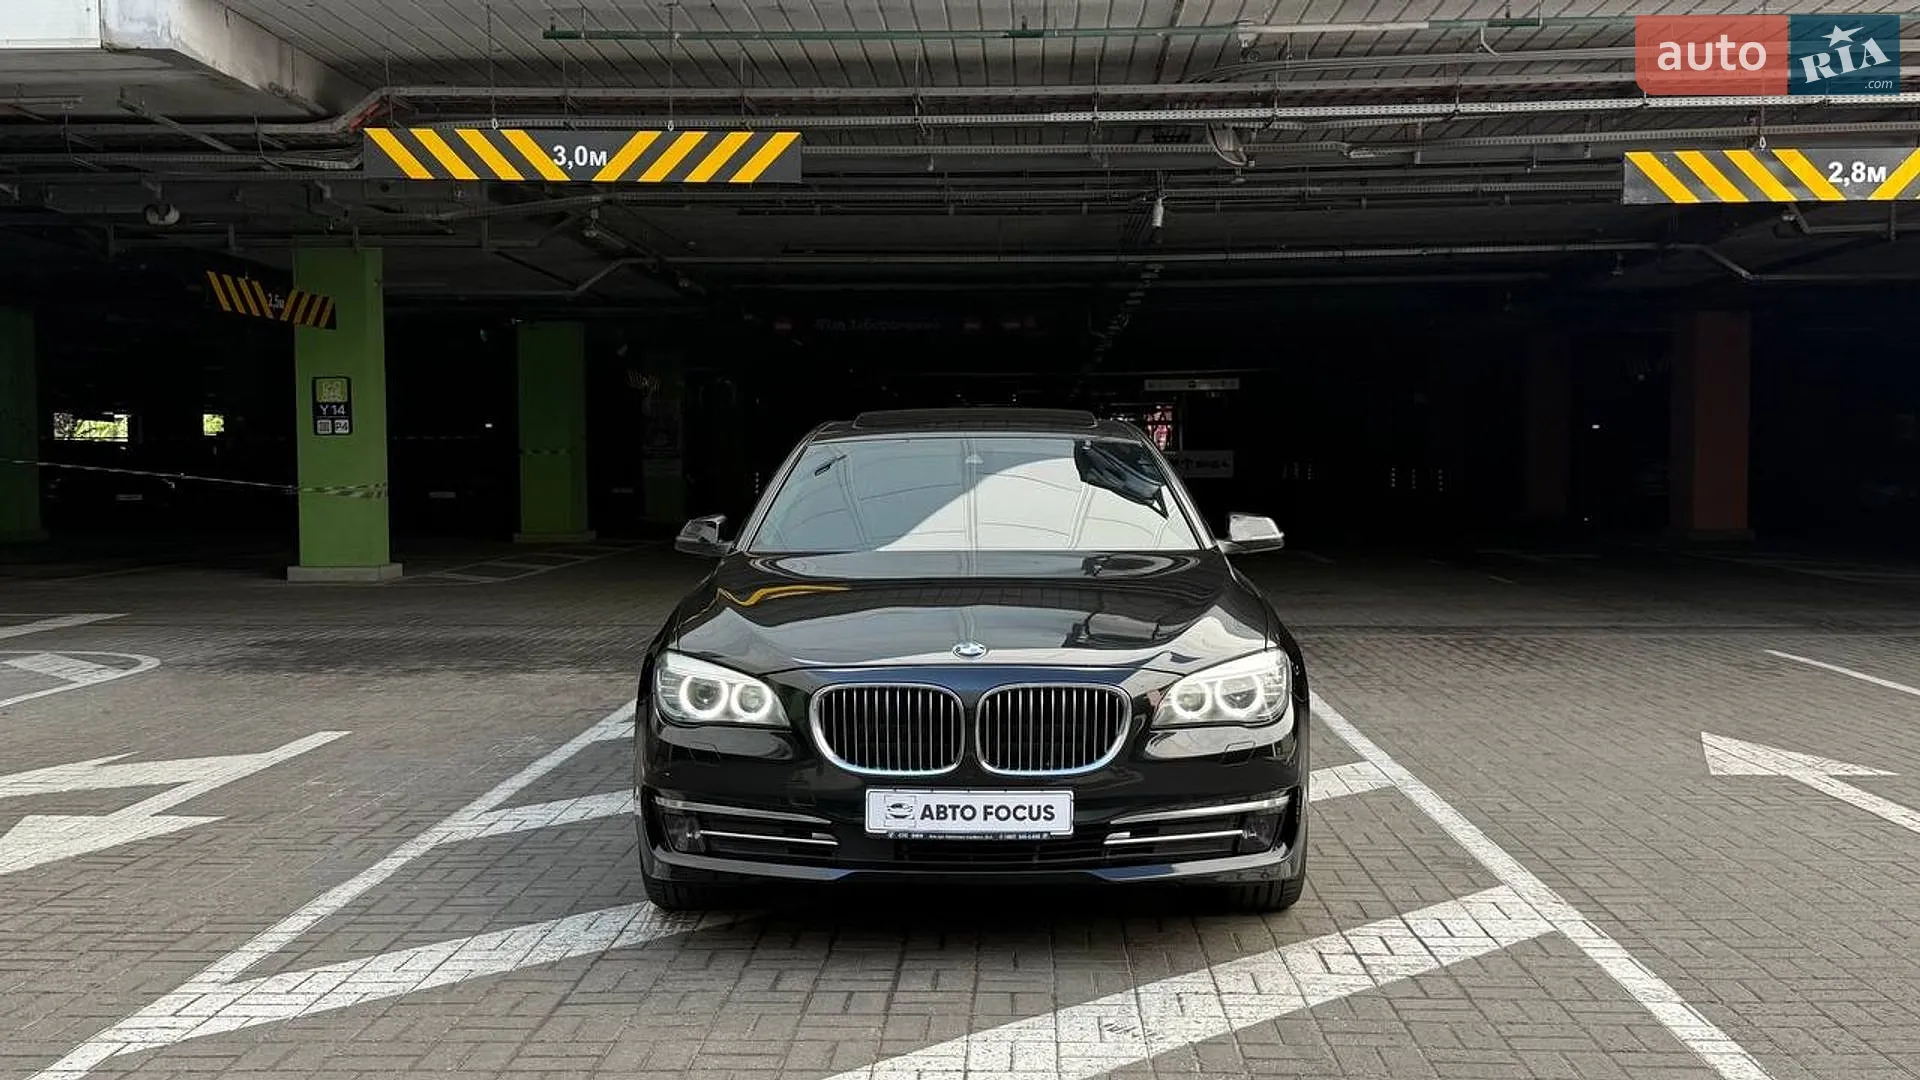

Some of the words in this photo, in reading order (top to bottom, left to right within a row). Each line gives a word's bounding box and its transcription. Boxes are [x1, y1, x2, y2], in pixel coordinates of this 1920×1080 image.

[553, 145, 608, 170] 3,0м
[1828, 160, 1887, 188] 2,8м
[331, 404, 346, 415] 14
[983, 803, 1055, 822] FOCUS
